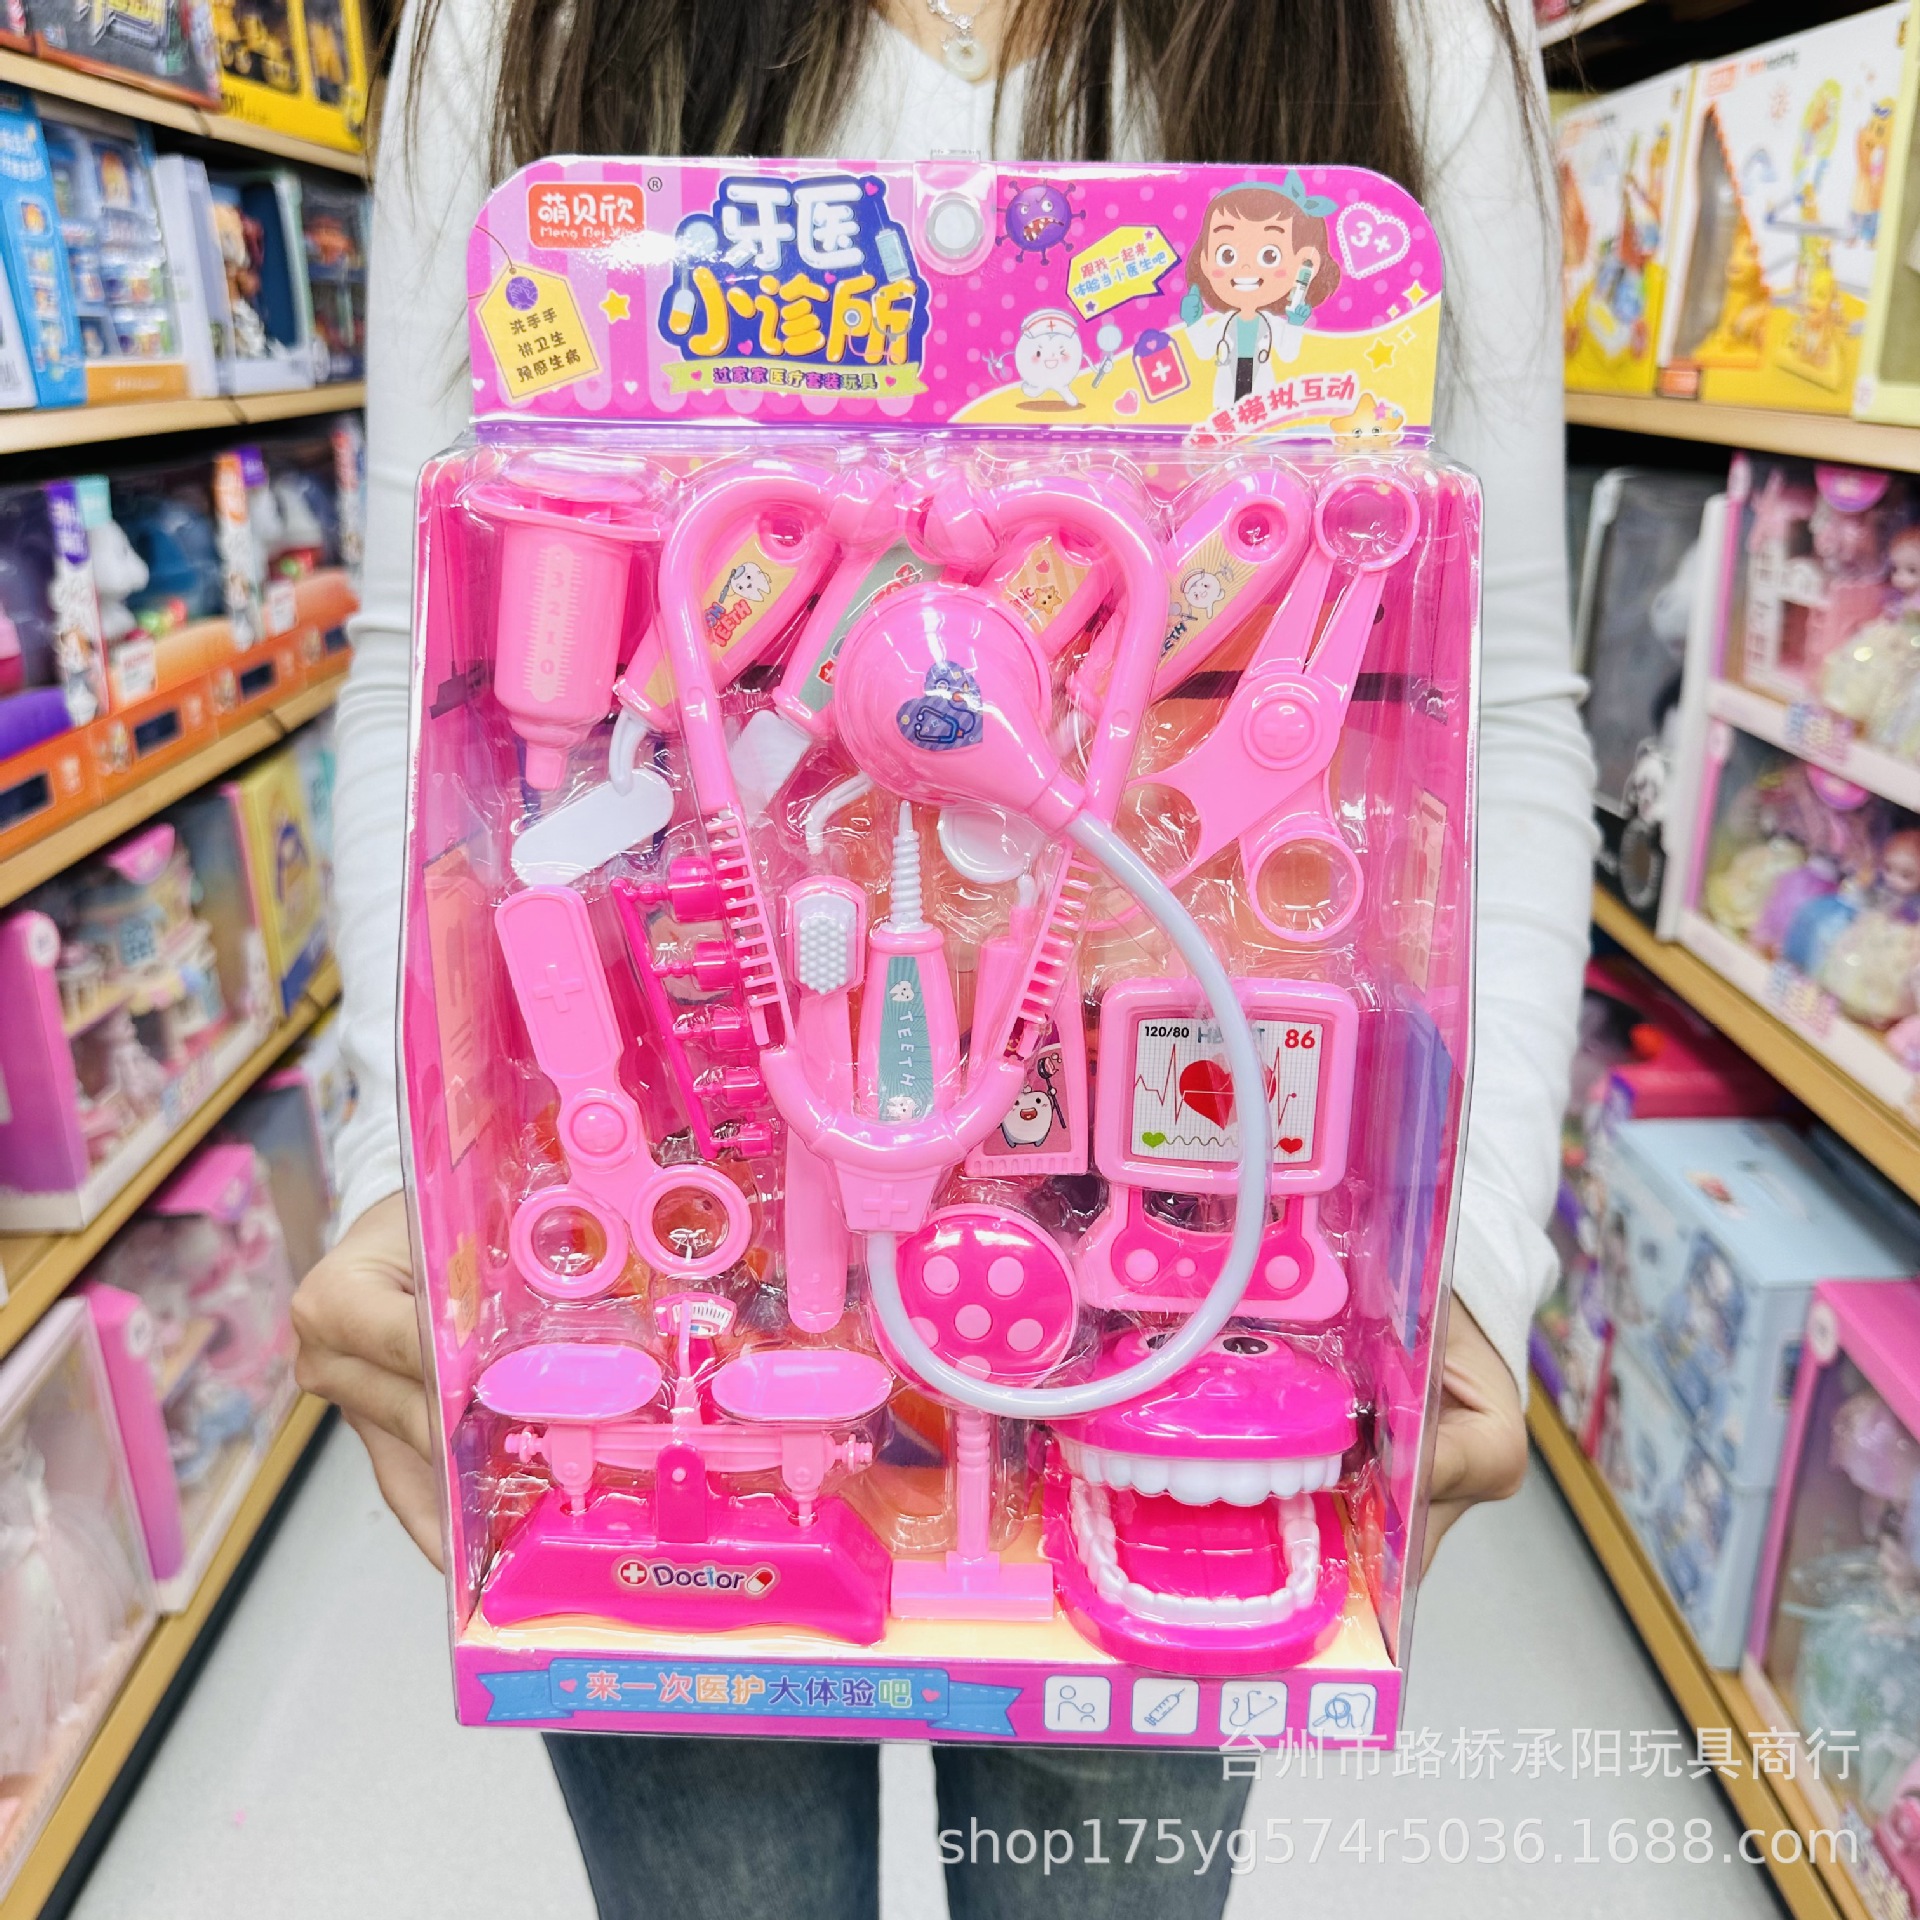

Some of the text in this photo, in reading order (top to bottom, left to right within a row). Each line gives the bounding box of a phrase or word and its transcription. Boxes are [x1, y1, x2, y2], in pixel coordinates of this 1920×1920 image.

[538, 192, 636, 227] 萌贝欣
[721, 184, 865, 272] 牙医
[1350, 221, 1392, 254] 3+
[1072, 251, 1168, 297] 体验当小医生吧
[1080, 242, 1148, 278] 跟我一起来
[669, 265, 917, 365] 小诊所
[712, 366, 879, 391] 过家家医疗套装玩具
[897, 1010, 916, 1087] TEETH
[1144, 1026, 1190, 1038] 120/80
[1284, 1029, 1316, 1049] 86
[652, 1564, 745, 1589] Doctor
[586, 1669, 913, 1708] 来一次医护大体验吧
